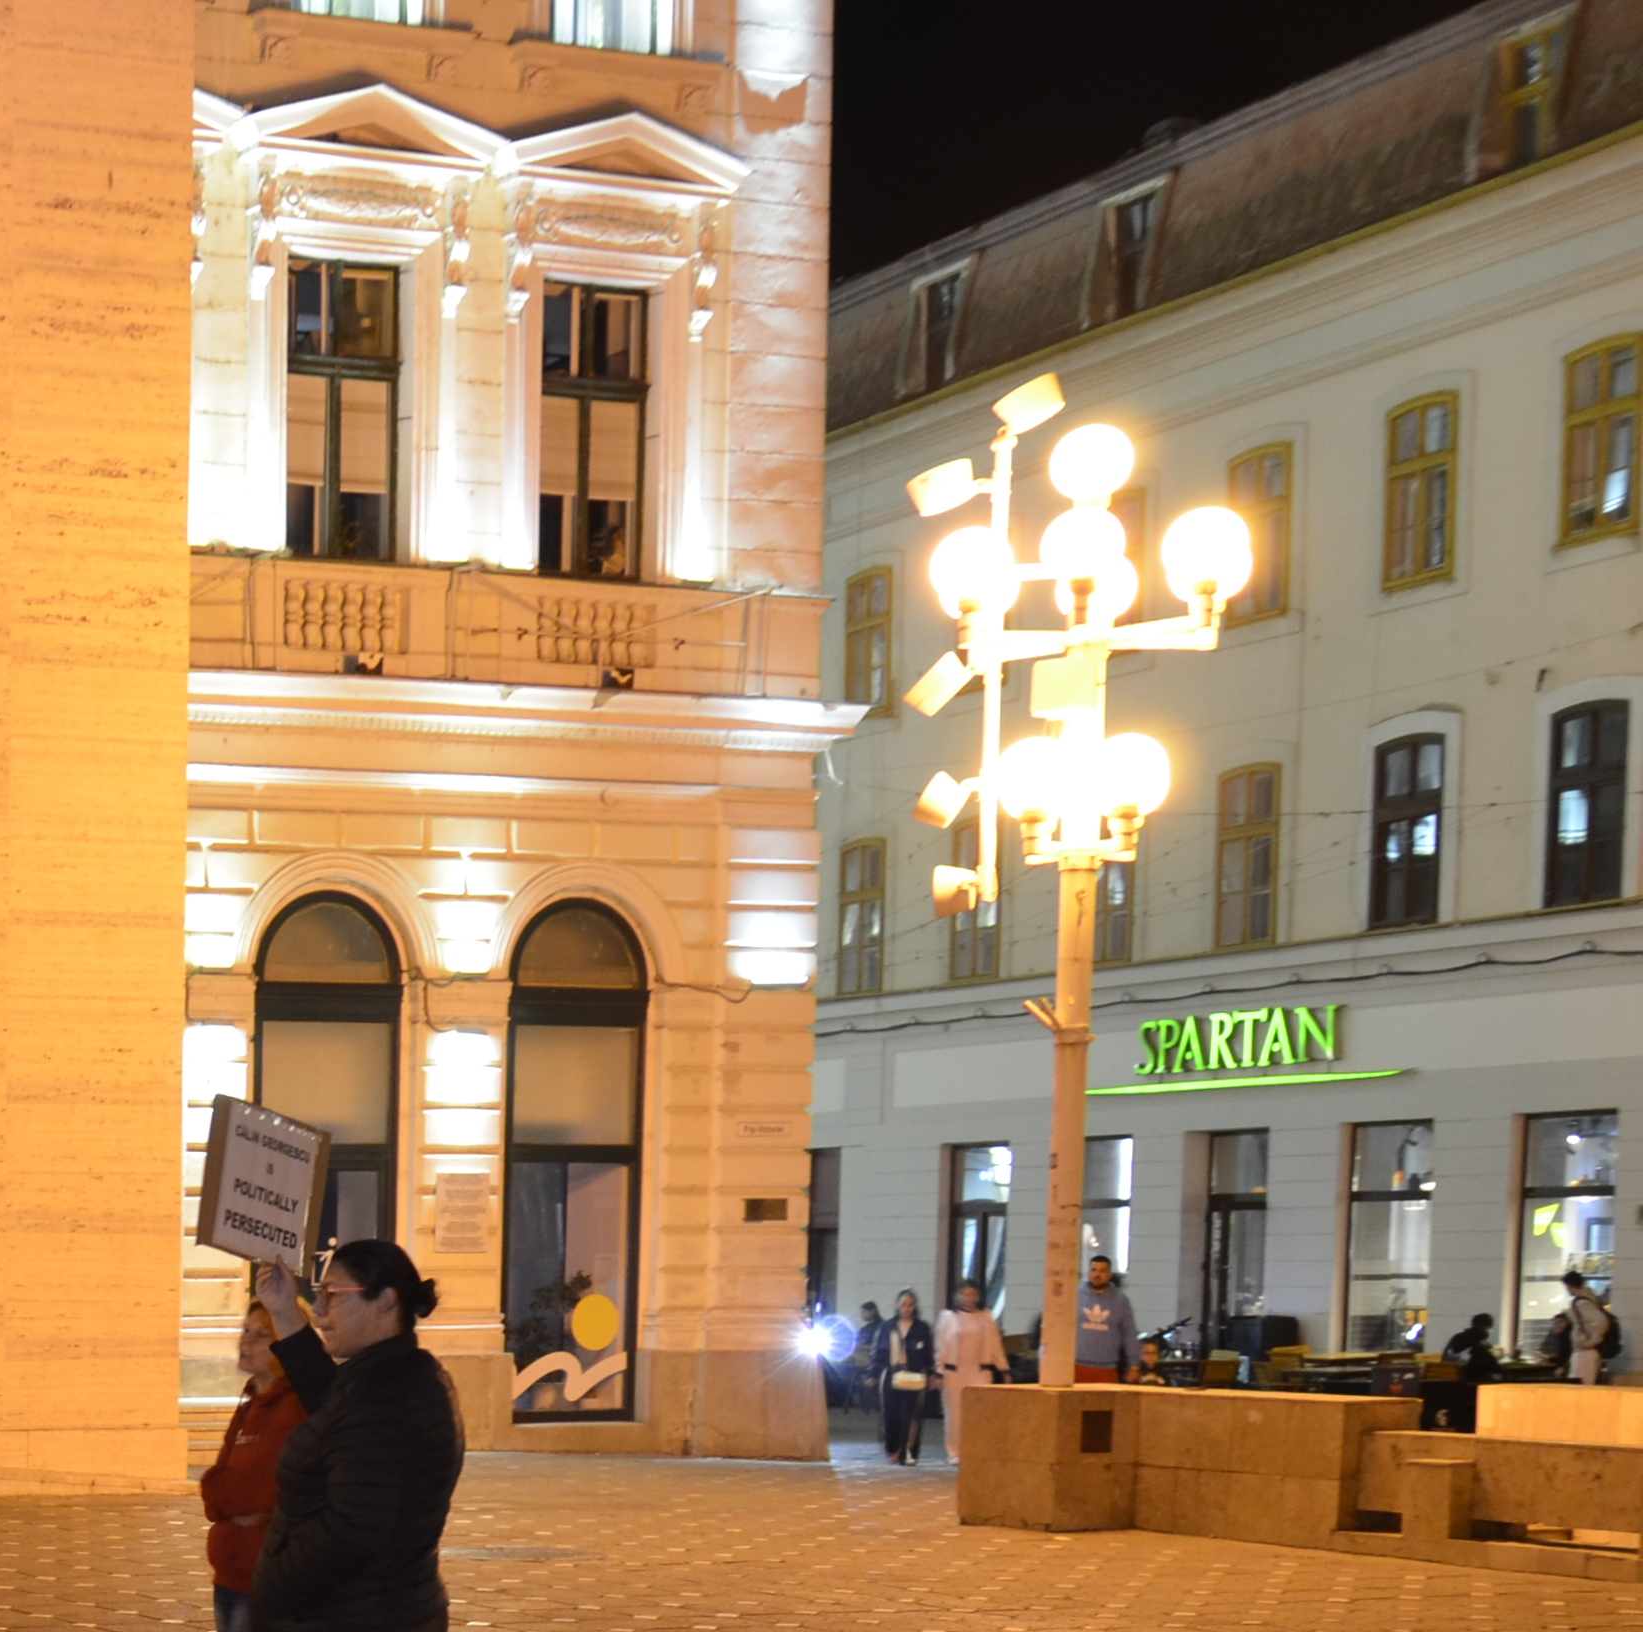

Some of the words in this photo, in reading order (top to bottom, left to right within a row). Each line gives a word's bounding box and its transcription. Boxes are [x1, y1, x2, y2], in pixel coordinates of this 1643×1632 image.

[1134, 1004, 1340, 1075] SPARTAN
[262, 1134, 310, 1163] GEORGESCU
[233, 1178, 298, 1214] POLITICALLY
[224, 1209, 297, 1249] PERSECUTED
